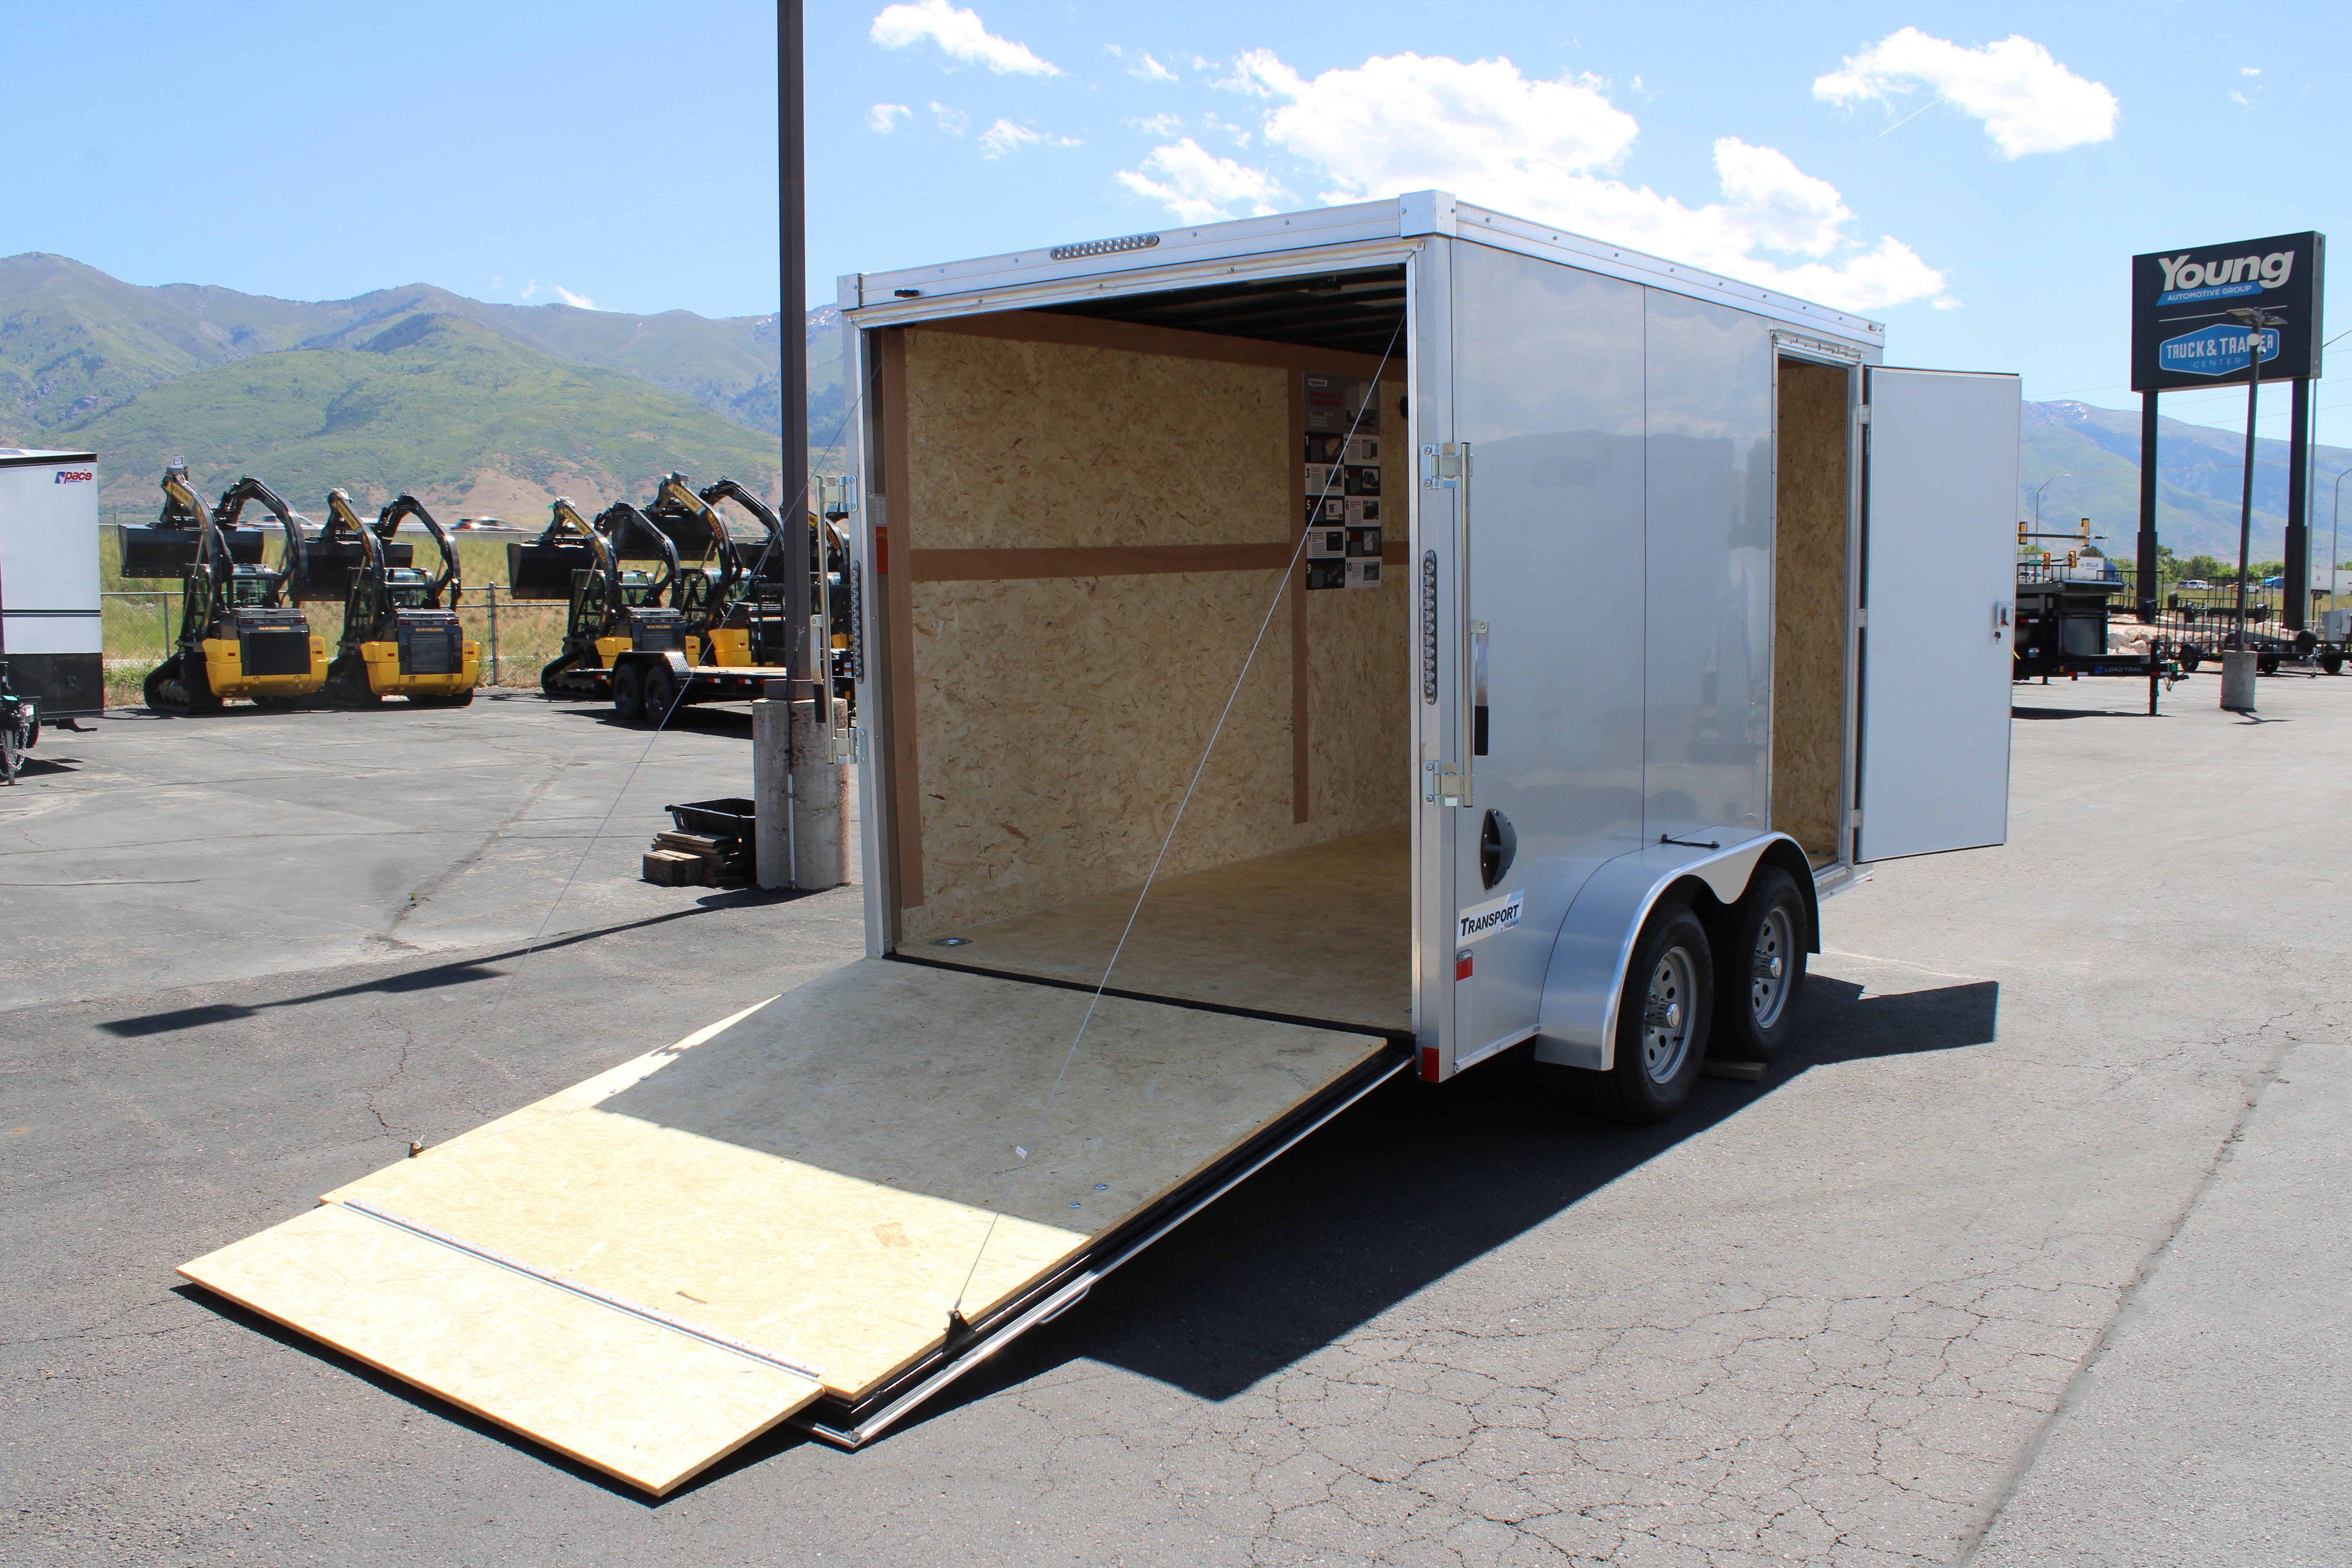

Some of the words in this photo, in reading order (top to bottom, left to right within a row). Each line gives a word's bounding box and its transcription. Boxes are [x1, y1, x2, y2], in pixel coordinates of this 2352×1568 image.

[2158, 251, 2295, 292] Young
[2167, 288, 2220, 301] AUTOMOTIVE
[2222, 285, 2252, 295] GROUP
[2166, 341, 2205, 359] TRUCK
[2206, 339, 2217, 356] &
[2219, 334, 2274, 355] TRAIER
[2193, 357, 2241, 368] CENTER
[64, 472, 93, 484] pace
[682, 492, 698, 509] HOLLAND
[1346, 562, 1352, 572] 10
[1461, 904, 1519, 937] TRANSPORT
